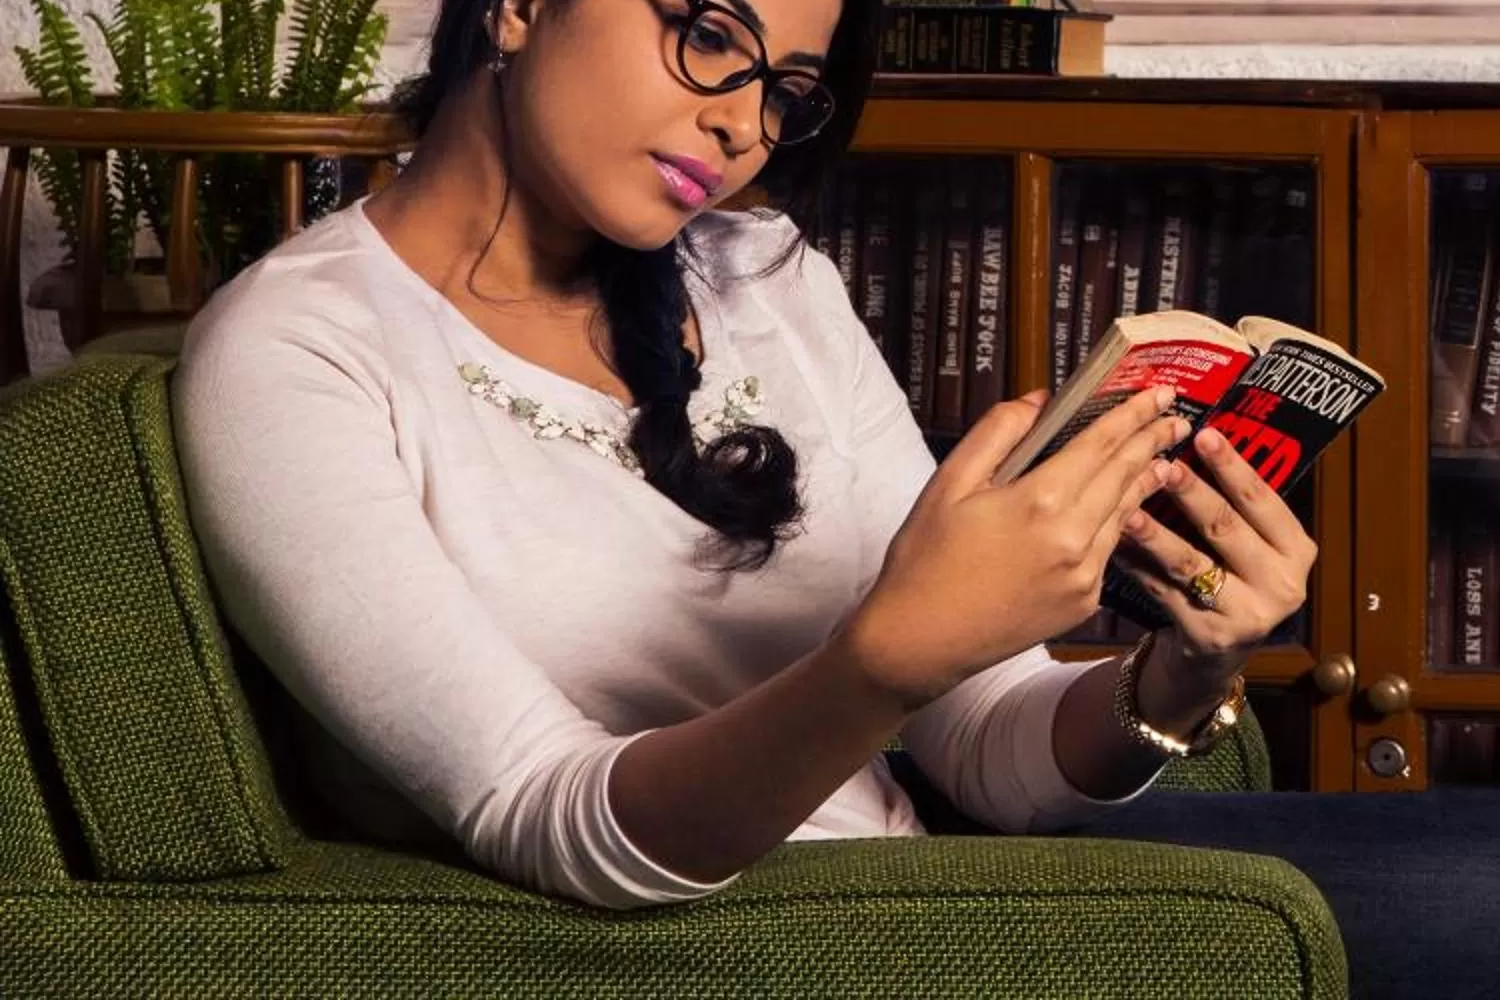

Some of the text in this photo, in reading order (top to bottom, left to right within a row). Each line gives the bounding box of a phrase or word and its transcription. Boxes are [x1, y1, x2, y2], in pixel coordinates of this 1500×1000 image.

[865, 274, 887, 318] LONG
[1055, 265, 1071, 308] JACOB
[975, 314, 996, 373] JOCK
[1263, 356, 1367, 424] PATTERSON
[1301, 350, 1325, 365] TIMES
[1323, 359, 1376, 393] BESTSELLER
[1235, 388, 1282, 420] THE
[1368, 593, 1380, 611] 3
[1465, 567, 1482, 616] LOSS
